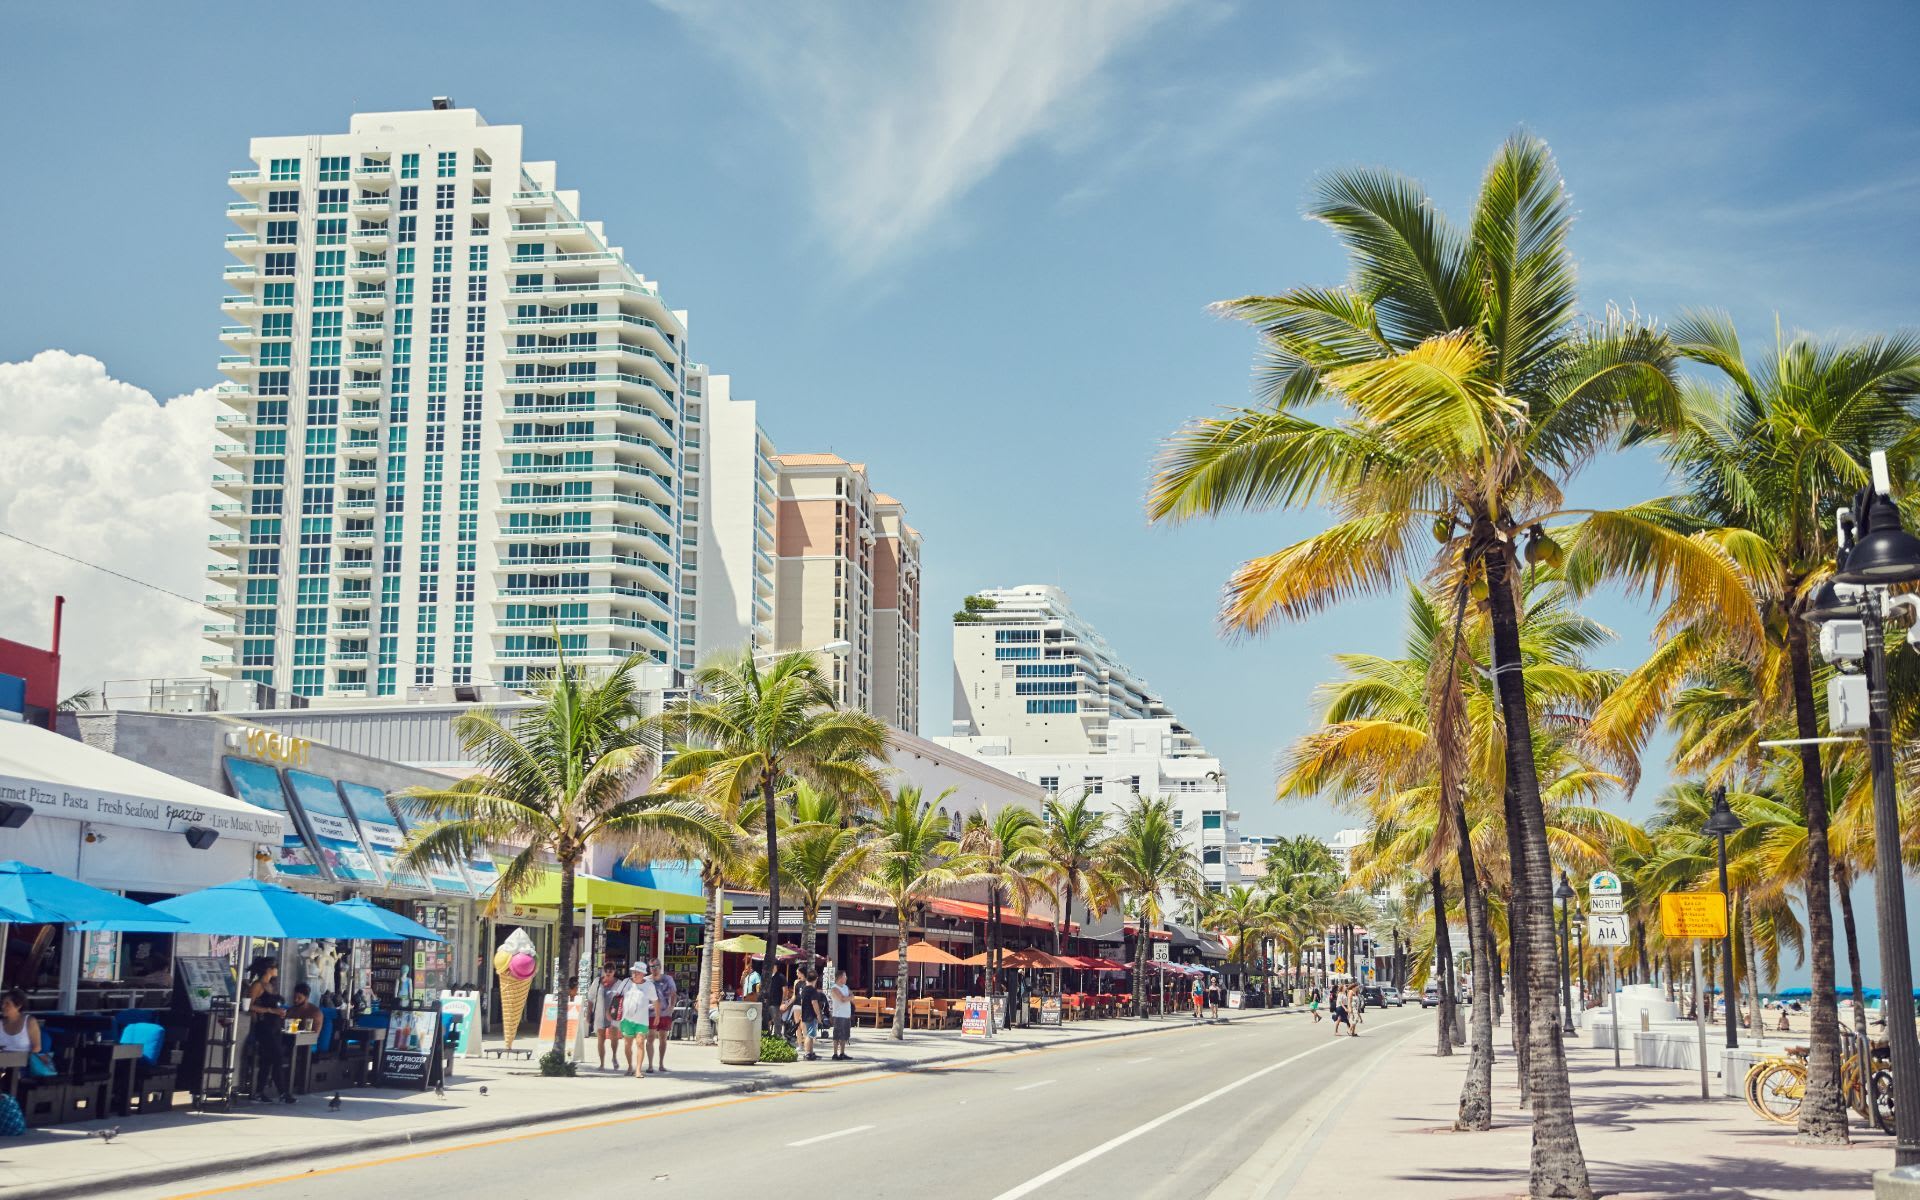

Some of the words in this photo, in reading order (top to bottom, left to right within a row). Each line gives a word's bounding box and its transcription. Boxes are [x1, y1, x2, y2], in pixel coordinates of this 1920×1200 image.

[246, 727, 311, 767] YOGURT
[30, 787, 56, 805] Pizza
[62, 792, 89, 809] Pasta
[97, 797, 122, 815] Fresh
[125, 801, 159, 819] Seafood
[212, 814, 229, 826] Live
[230, 816, 253, 832] Music
[254, 819, 282, 838] Nightly
[1592, 898, 1621, 910] NORTH
[1598, 927, 1618, 939] A1A
[1155, 952, 1168, 960] 30
[965, 1002, 988, 1010] FREE
